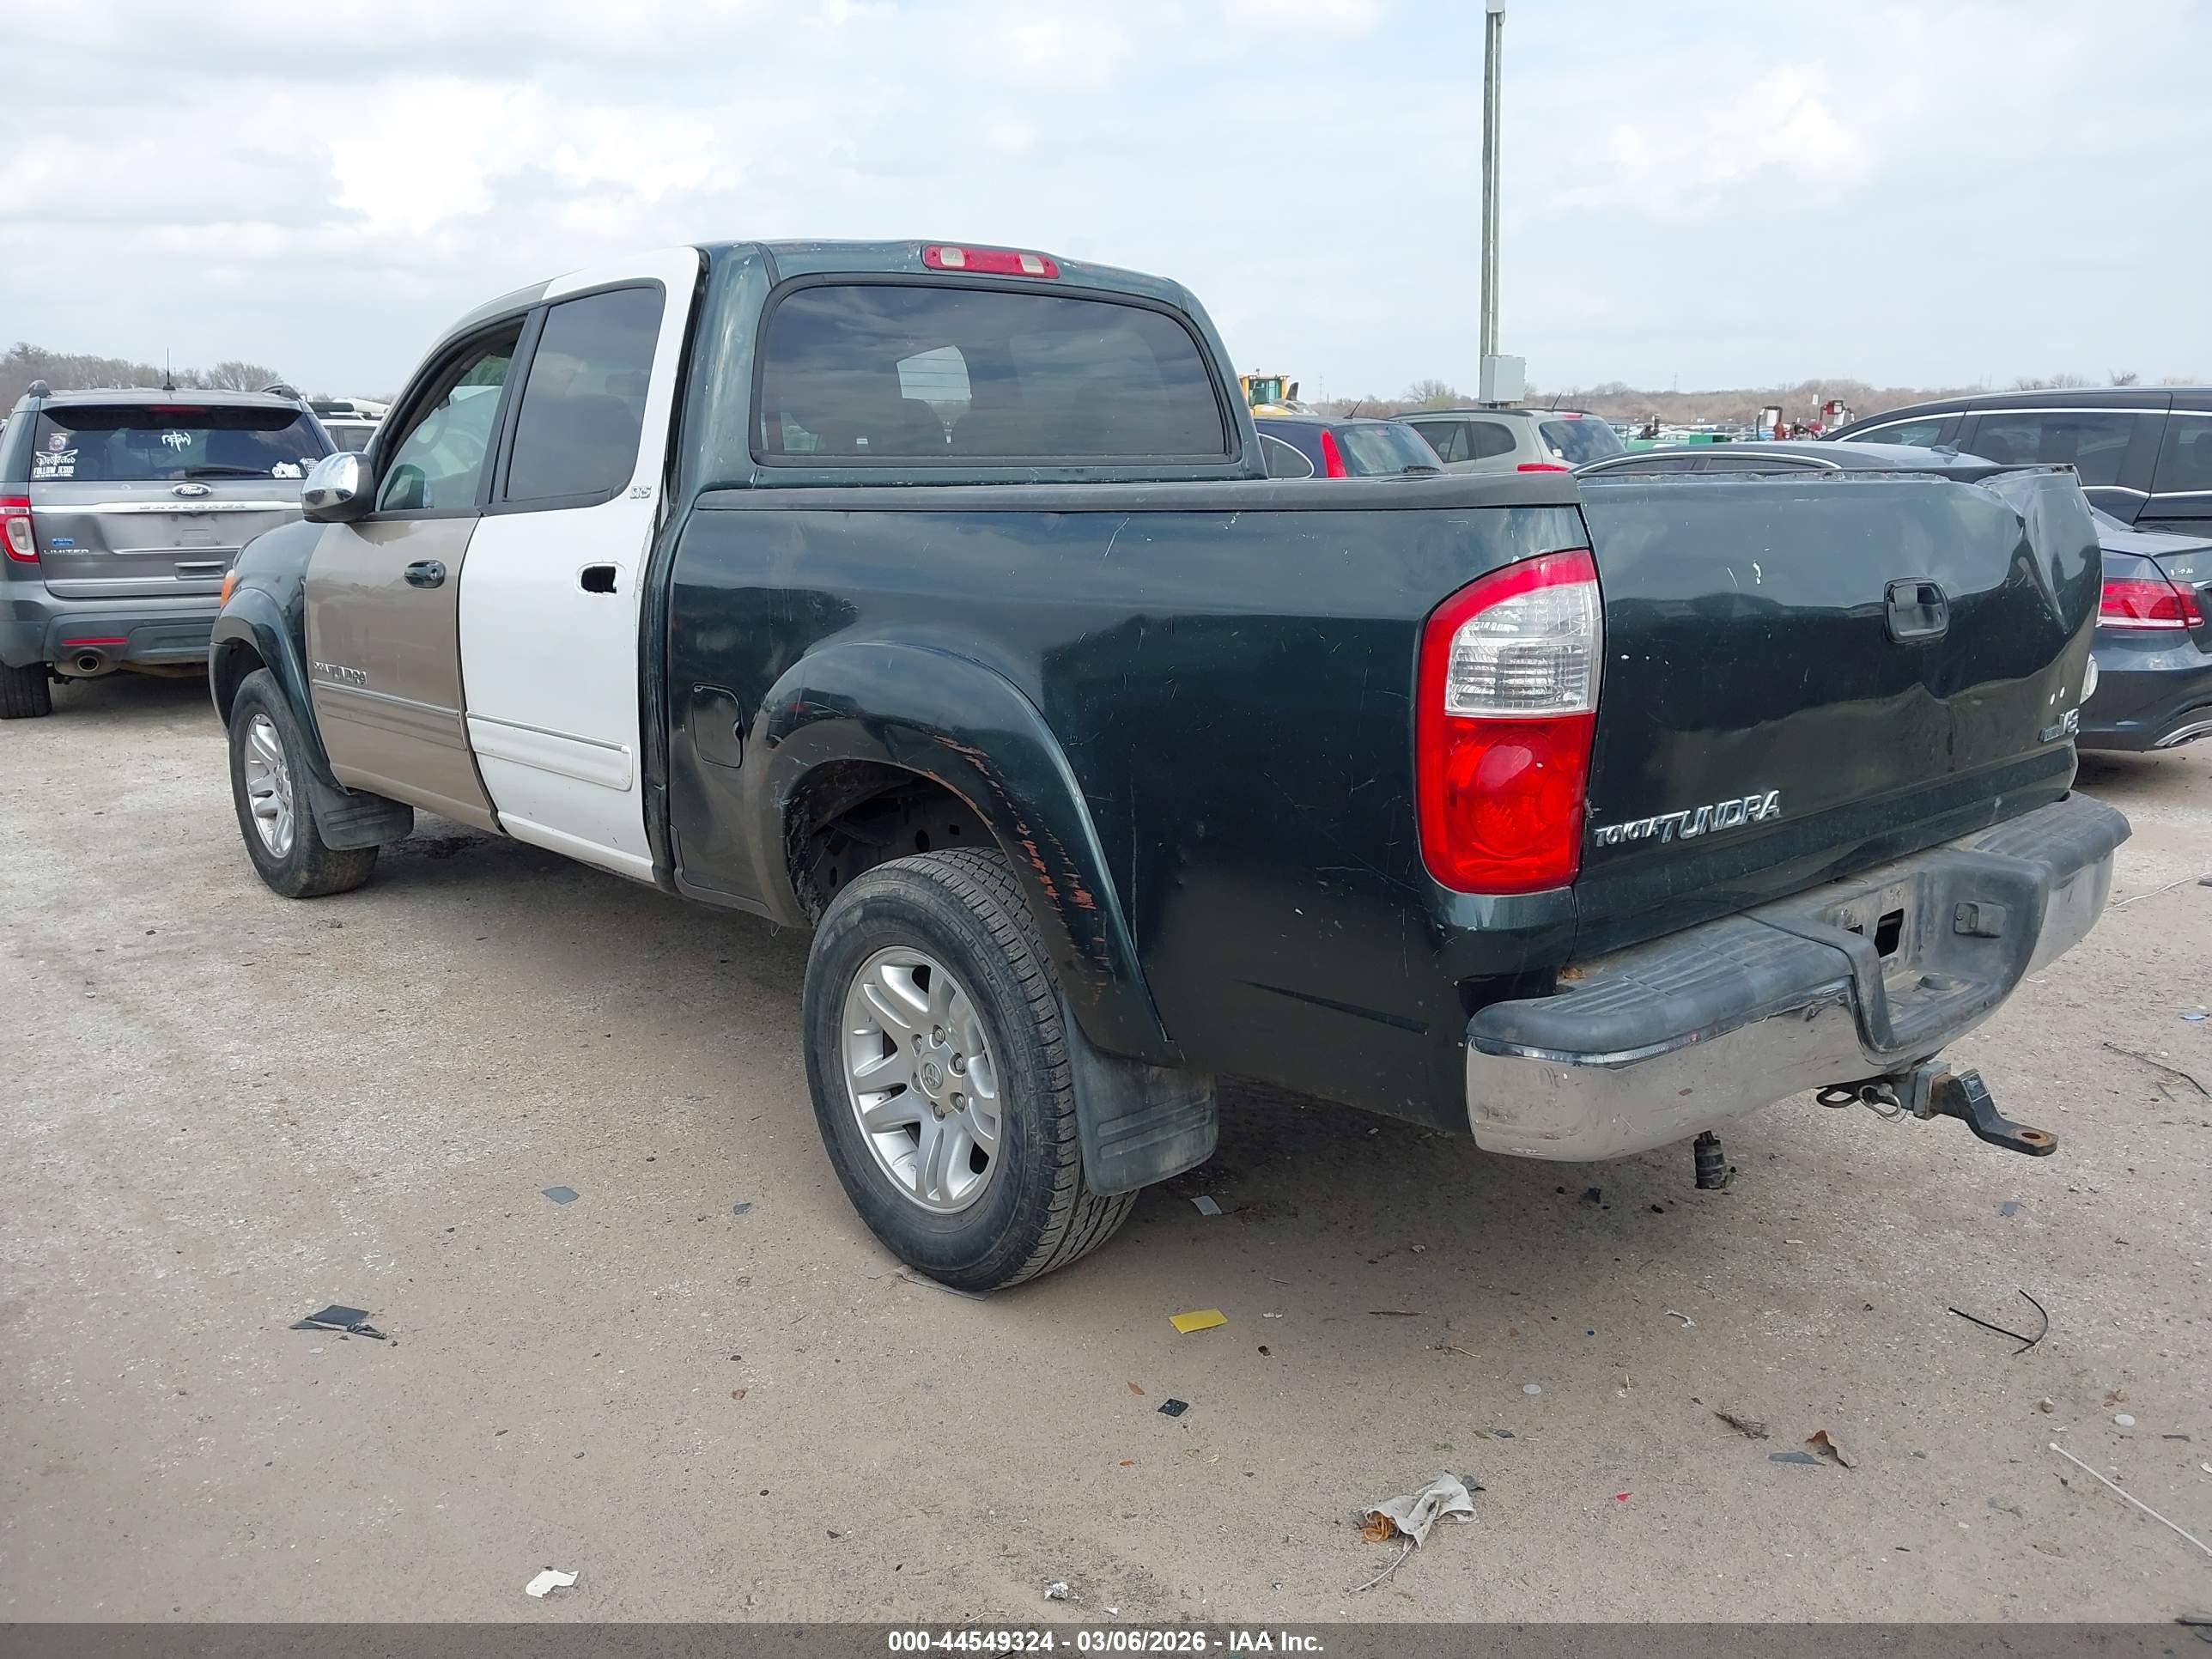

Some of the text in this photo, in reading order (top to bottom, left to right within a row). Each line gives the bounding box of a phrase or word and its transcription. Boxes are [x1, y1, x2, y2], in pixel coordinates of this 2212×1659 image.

[33, 466, 56, 475] FOLLOW
[1595, 790, 1781, 847] TOYOTA TUNDRA
